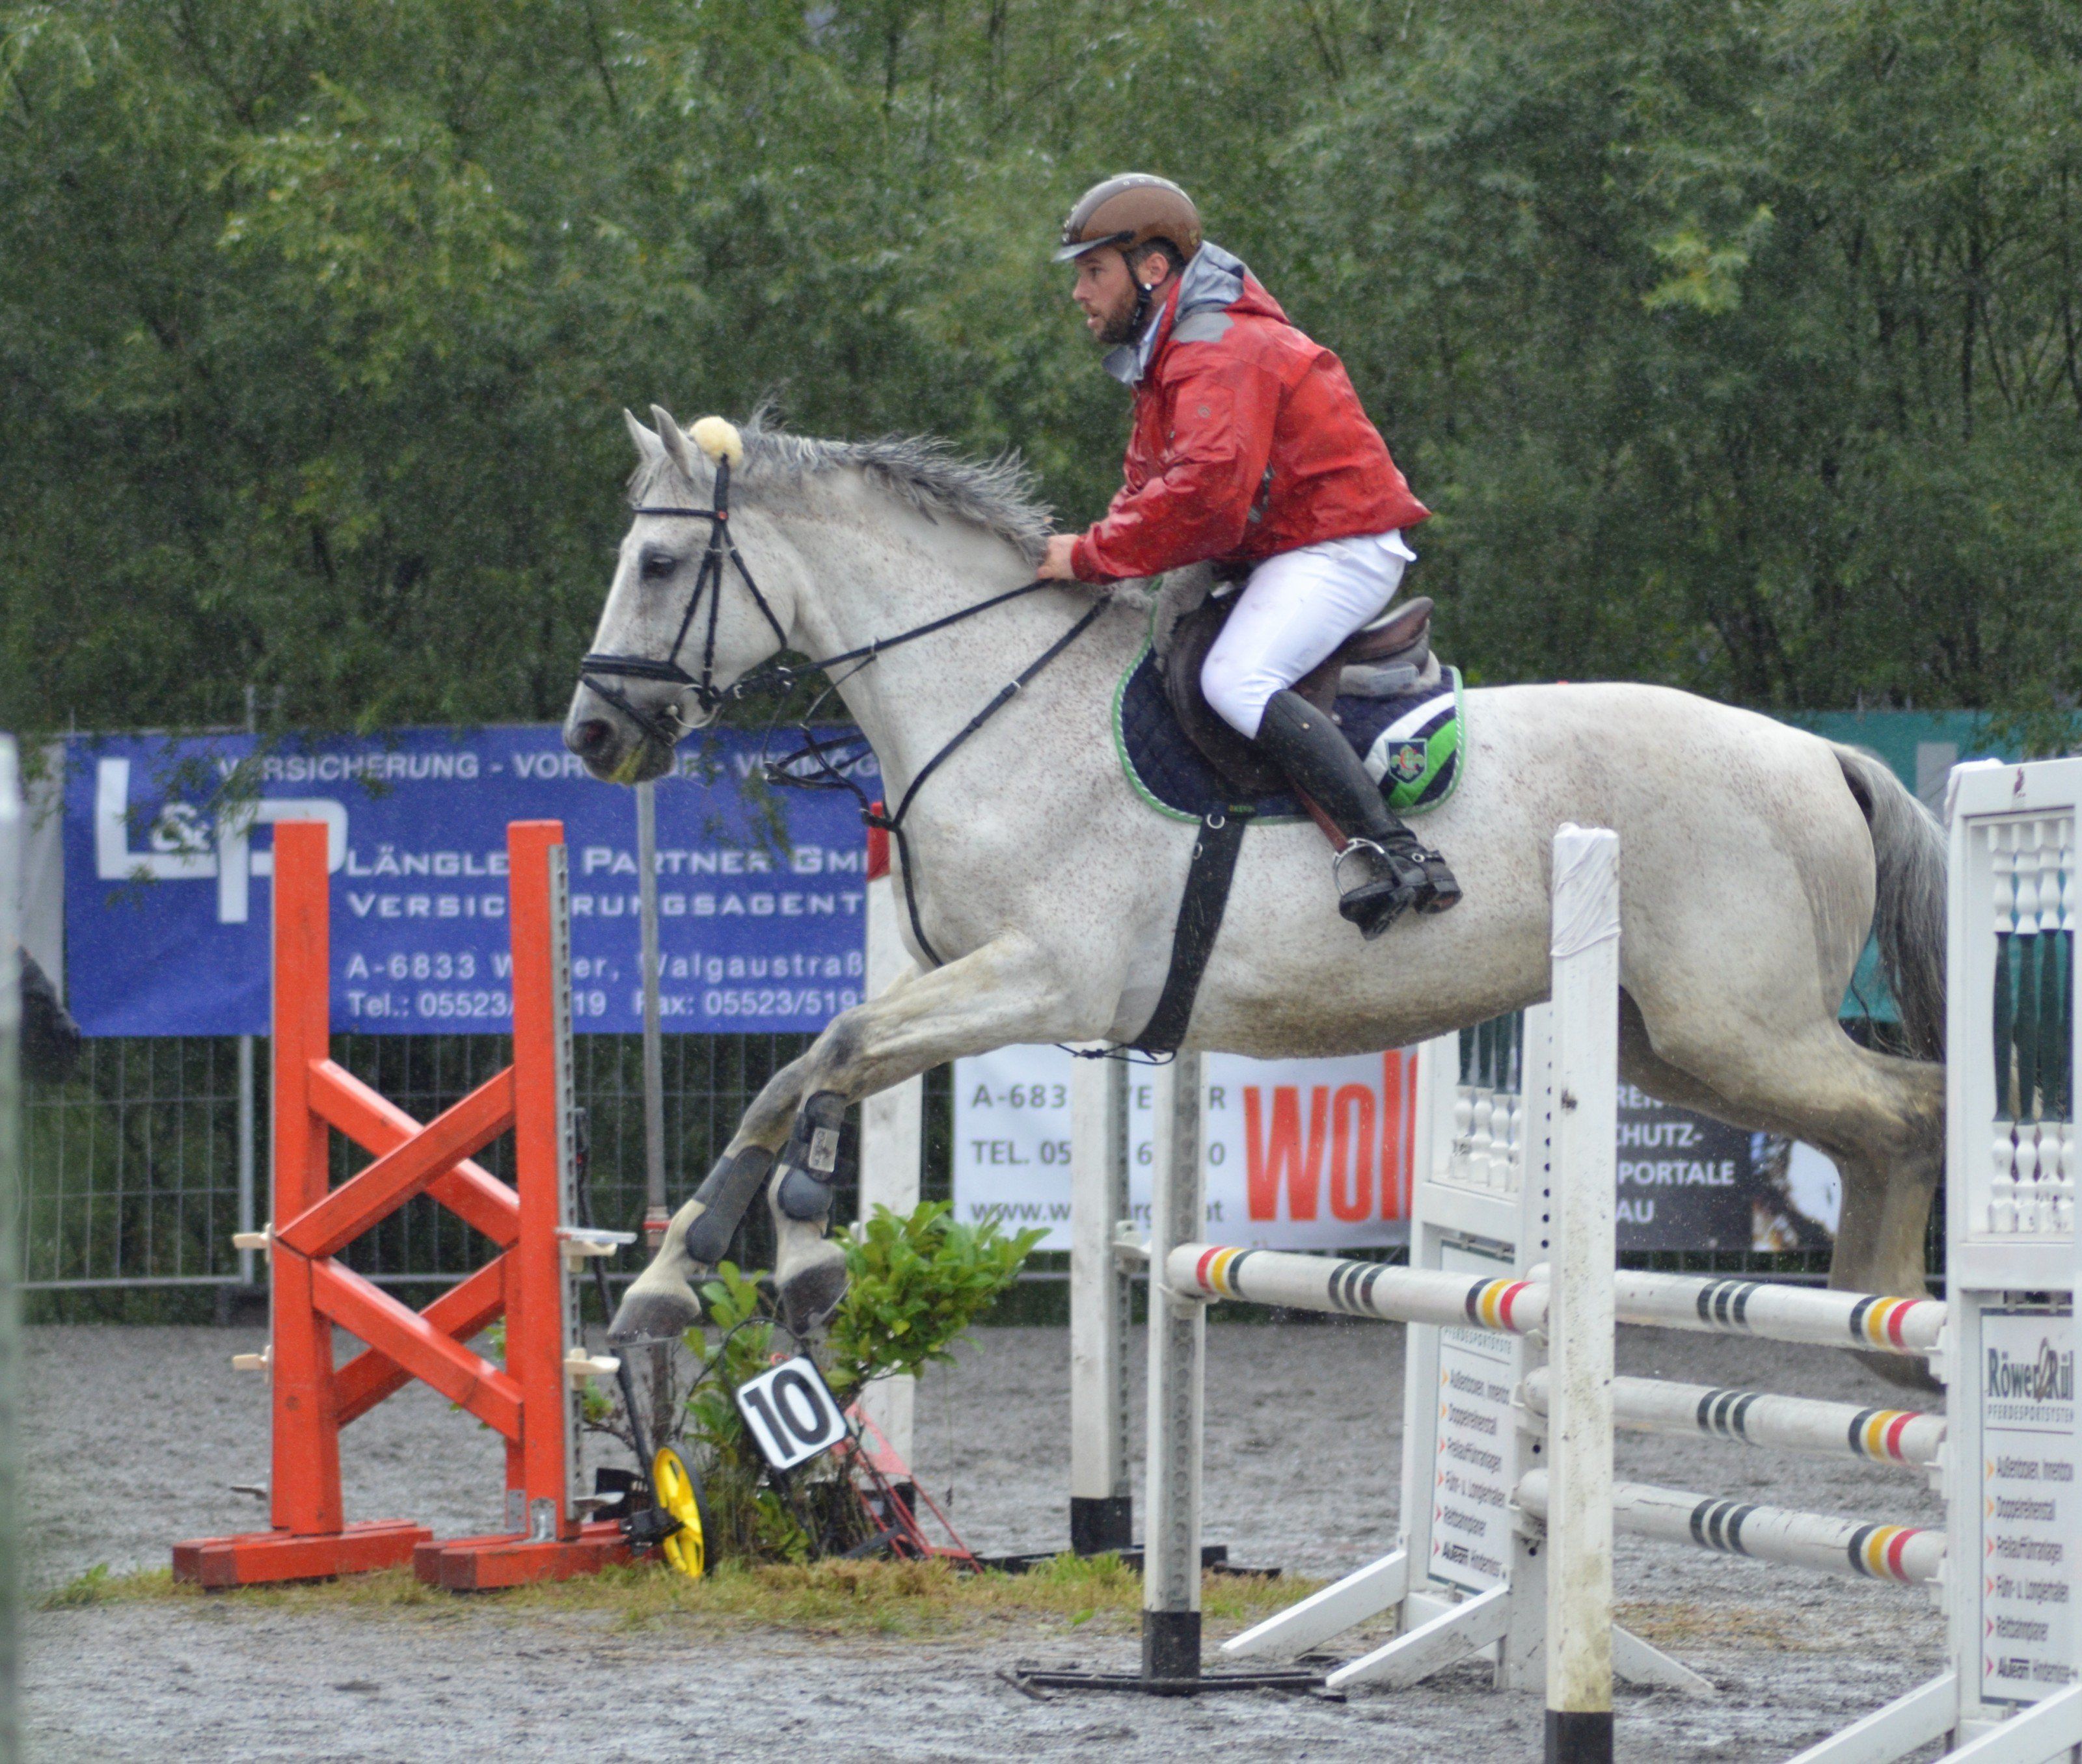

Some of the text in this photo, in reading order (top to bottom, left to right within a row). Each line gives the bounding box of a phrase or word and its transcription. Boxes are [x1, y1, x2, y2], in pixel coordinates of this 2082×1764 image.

[219, 753, 479, 781] VRSICHERUNG
[348, 953, 475, 979] A-6833
[491, 953, 619, 982] Wer,
[347, 991, 410, 1017] Tel.:
[704, 989, 865, 1015] 05523/519
[972, 1083, 1068, 1109] A-683
[971, 1140, 1029, 1165] TEL.
[1616, 1199, 1655, 1224] AU
[742, 1369, 831, 1462] 10
